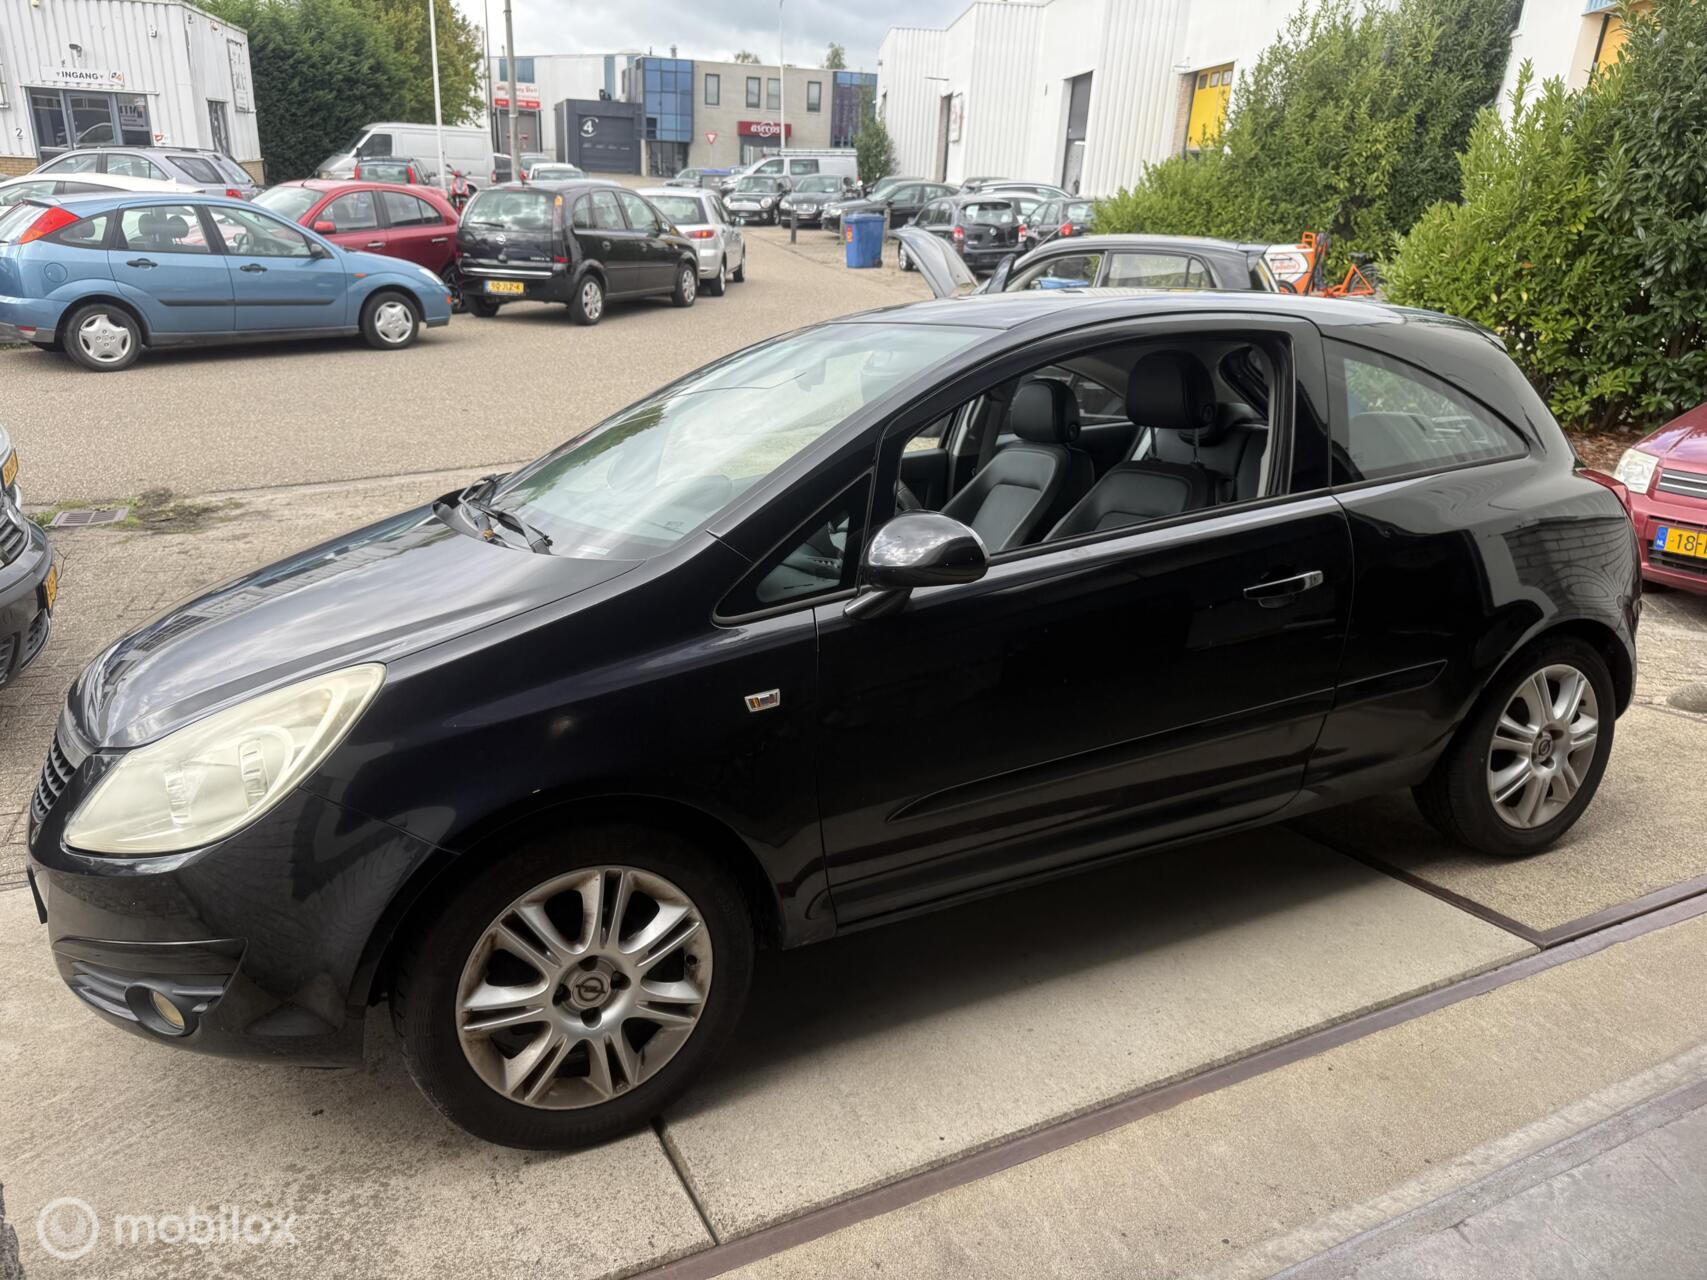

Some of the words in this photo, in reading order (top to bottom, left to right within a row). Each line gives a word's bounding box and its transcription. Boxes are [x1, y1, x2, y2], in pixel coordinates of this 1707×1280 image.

[61, 71, 99, 80] INGANG
[583, 120, 594, 133] 4
[15, 127, 24, 139] 2
[1677, 533, 1707, 554] 18-
